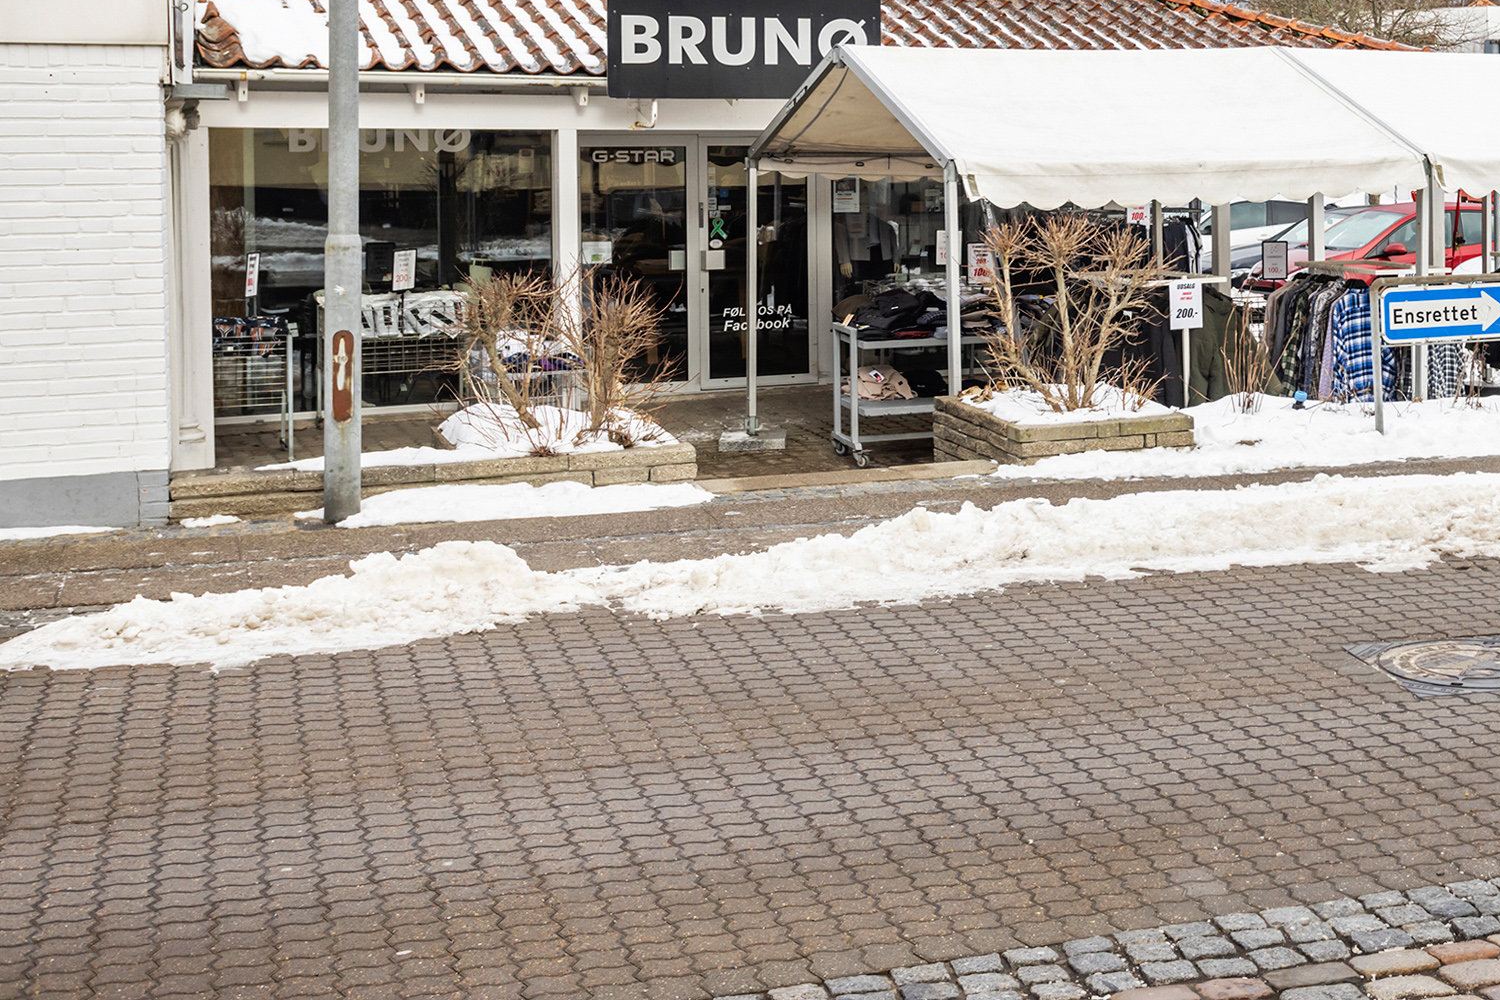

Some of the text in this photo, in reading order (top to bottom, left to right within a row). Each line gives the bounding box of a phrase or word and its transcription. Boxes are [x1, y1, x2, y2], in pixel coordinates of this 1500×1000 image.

[620, 14, 868, 66] BRUNØ
[288, 129, 471, 153] BUNØ
[592, 150, 675, 163] G-STAR
[722, 303, 793, 318] FØL OS PÅ
[1176, 307, 1198, 319] 200,-
[1393, 304, 1478, 325] Ensrettet
[723, 317, 790, 332] Facbook
